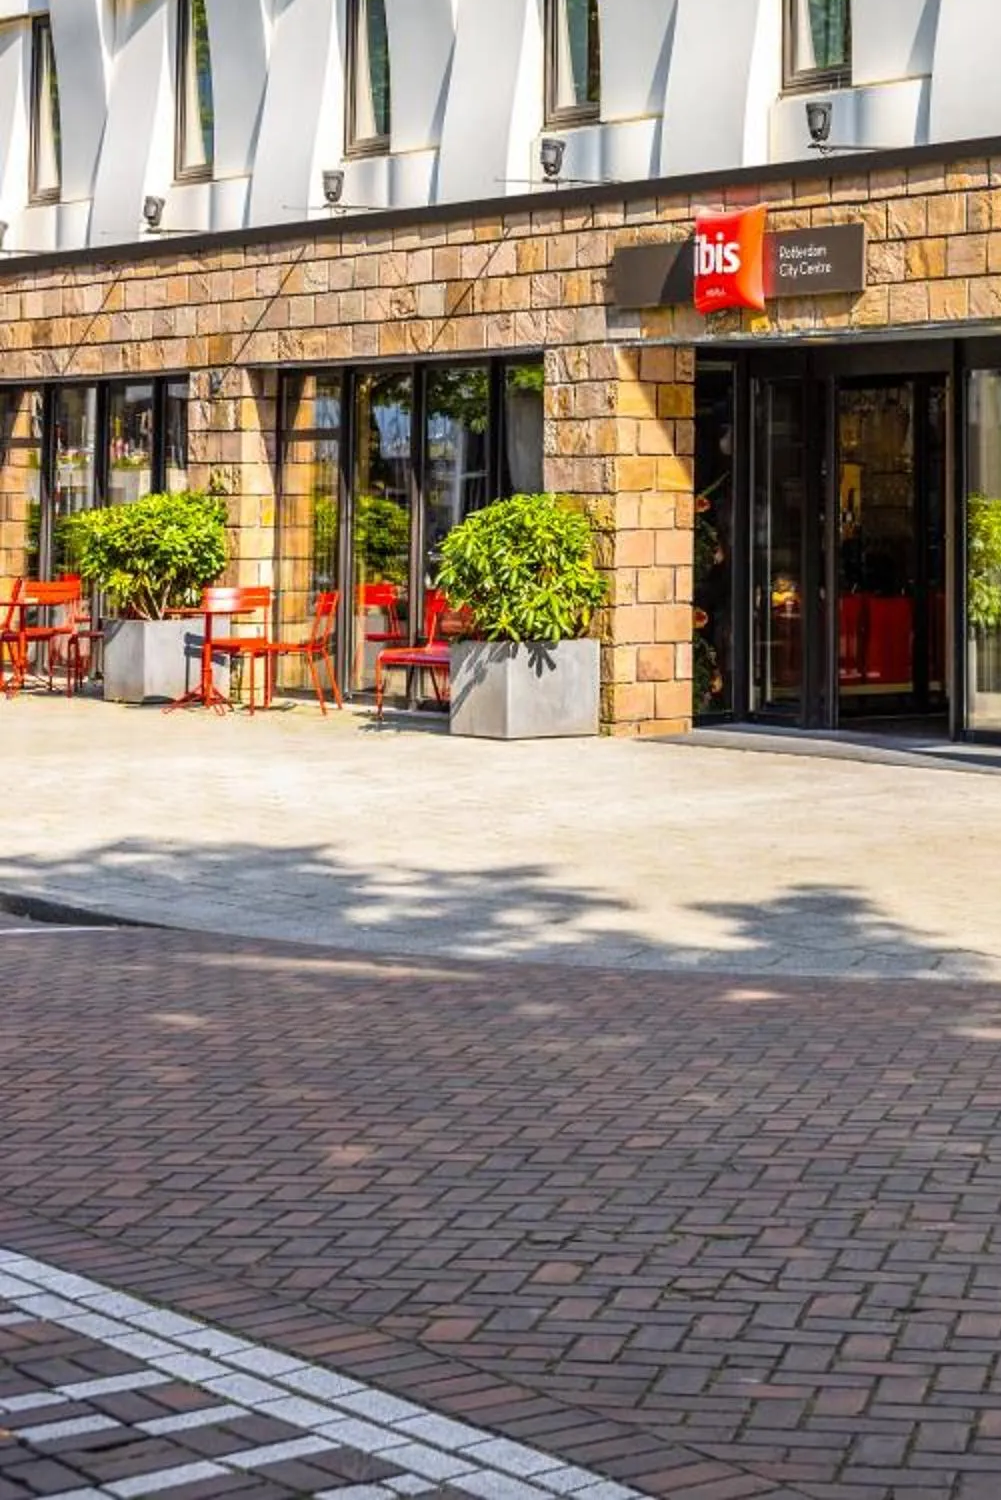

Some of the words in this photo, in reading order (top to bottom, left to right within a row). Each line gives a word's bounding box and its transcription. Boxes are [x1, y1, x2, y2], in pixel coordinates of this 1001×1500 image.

[694, 231, 741, 276] ibis
[779, 244, 827, 259] Rotterdam
[779, 263, 798, 279] City
[800, 261, 831, 275] Centre
